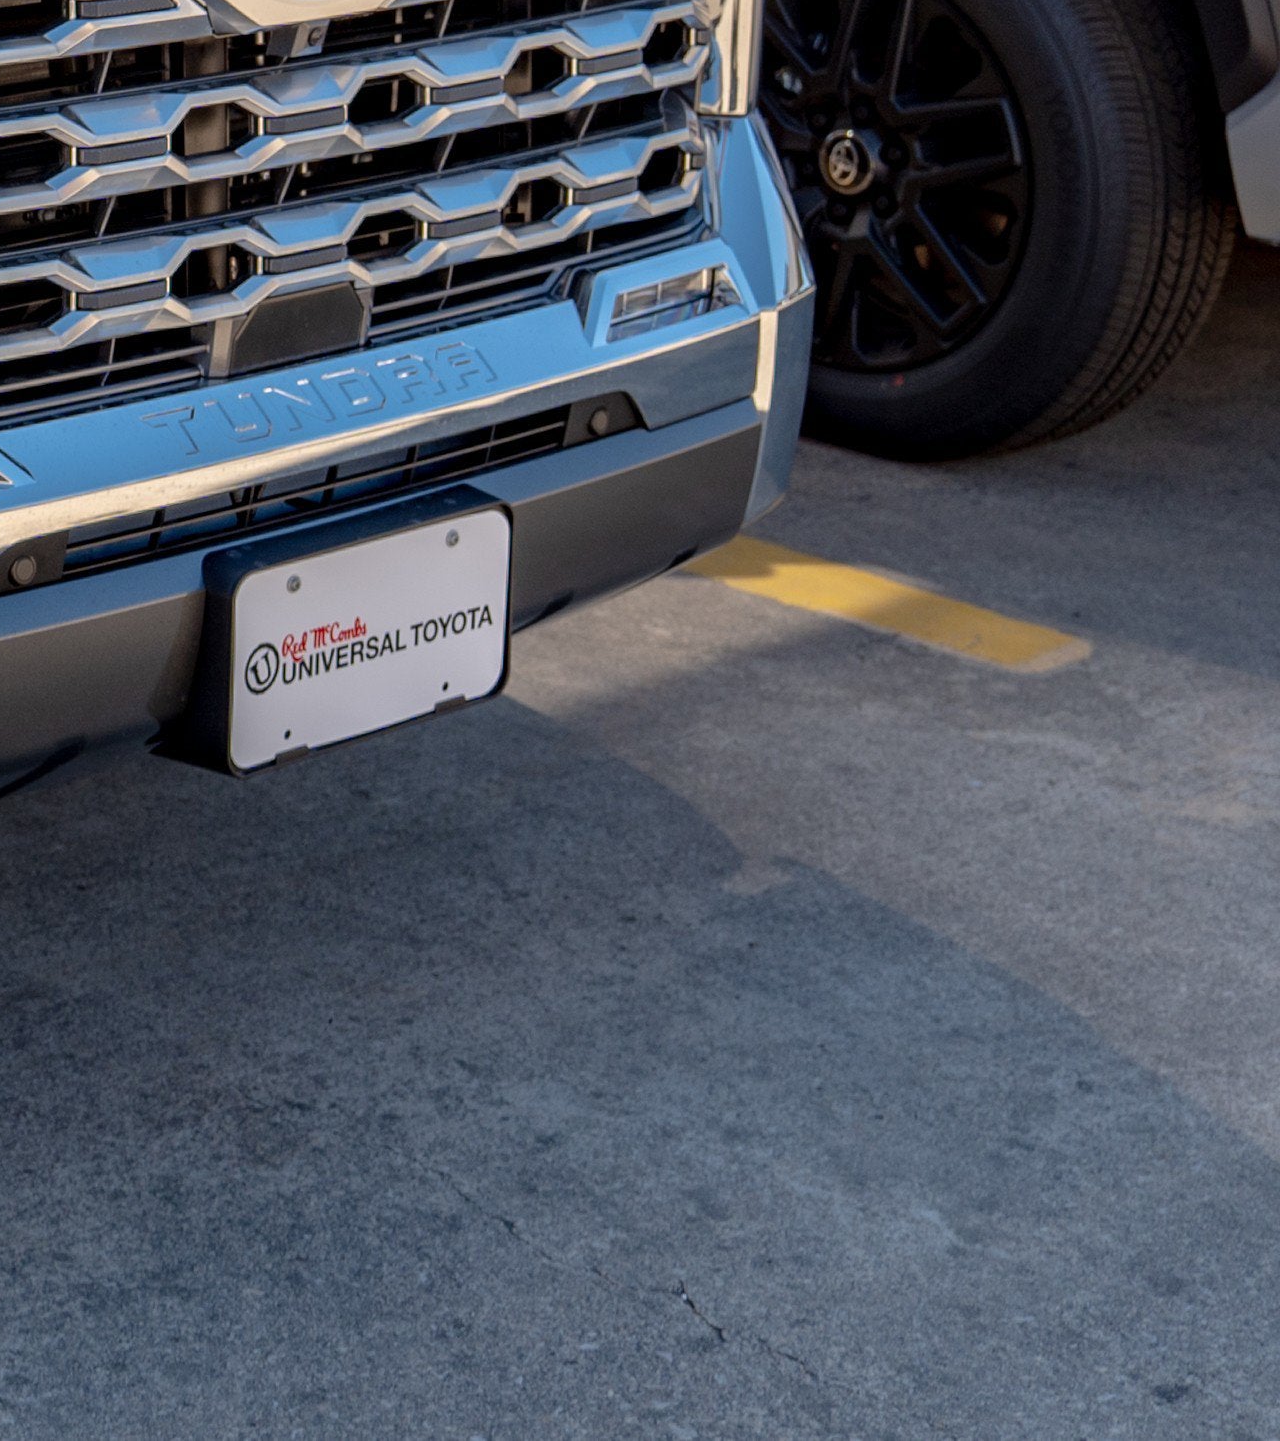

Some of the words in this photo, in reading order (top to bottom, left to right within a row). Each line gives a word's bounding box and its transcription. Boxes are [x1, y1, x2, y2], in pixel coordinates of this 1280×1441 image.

[141, 341, 498, 456] TUNDRA
[282, 629, 407, 685] UNIVERSAL
[411, 604, 493, 647] TOYOTA
[282, 631, 308, 663] Red
